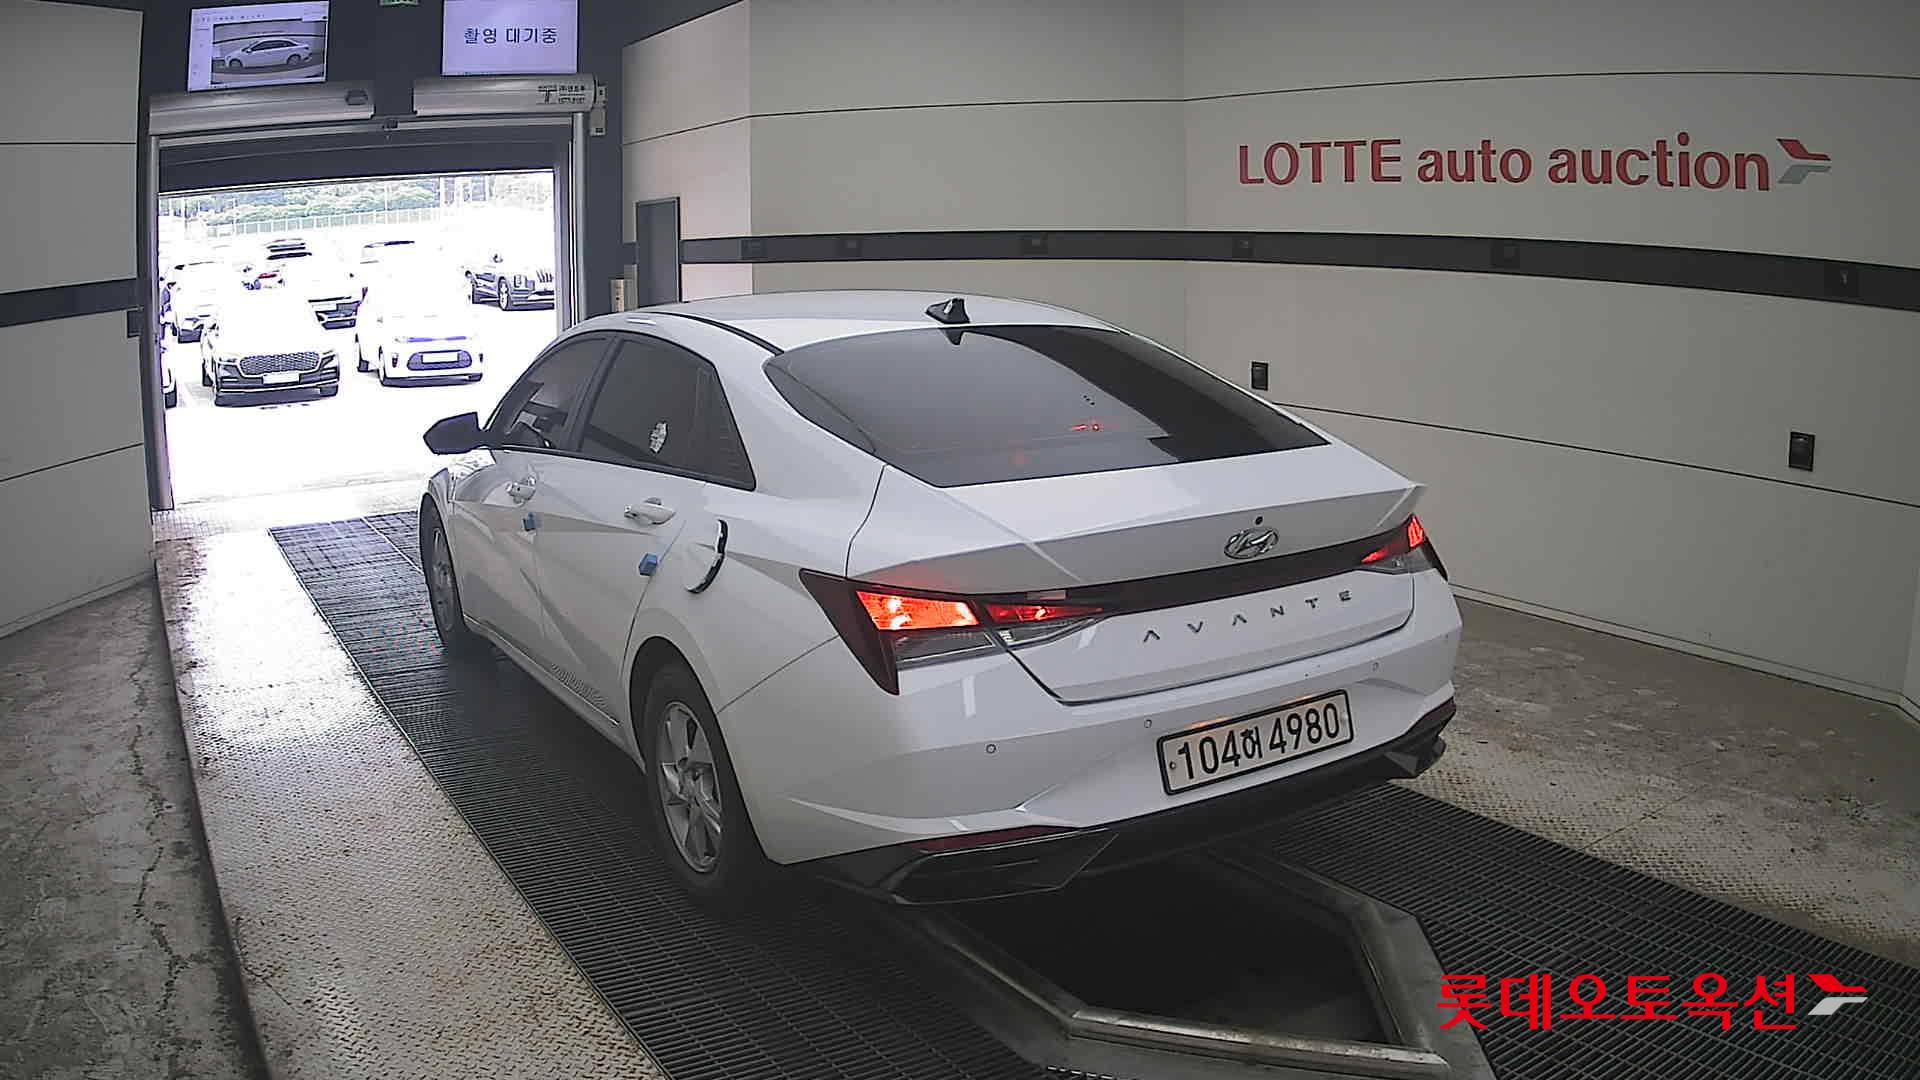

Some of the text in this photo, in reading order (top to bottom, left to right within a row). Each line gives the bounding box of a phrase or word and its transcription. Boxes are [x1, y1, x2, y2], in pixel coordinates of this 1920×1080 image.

[464, 27, 558, 45] 촬영 대기중
[1240, 132, 1769, 190] LOTTE auto auction
[1143, 590, 1353, 643] AVANTE
